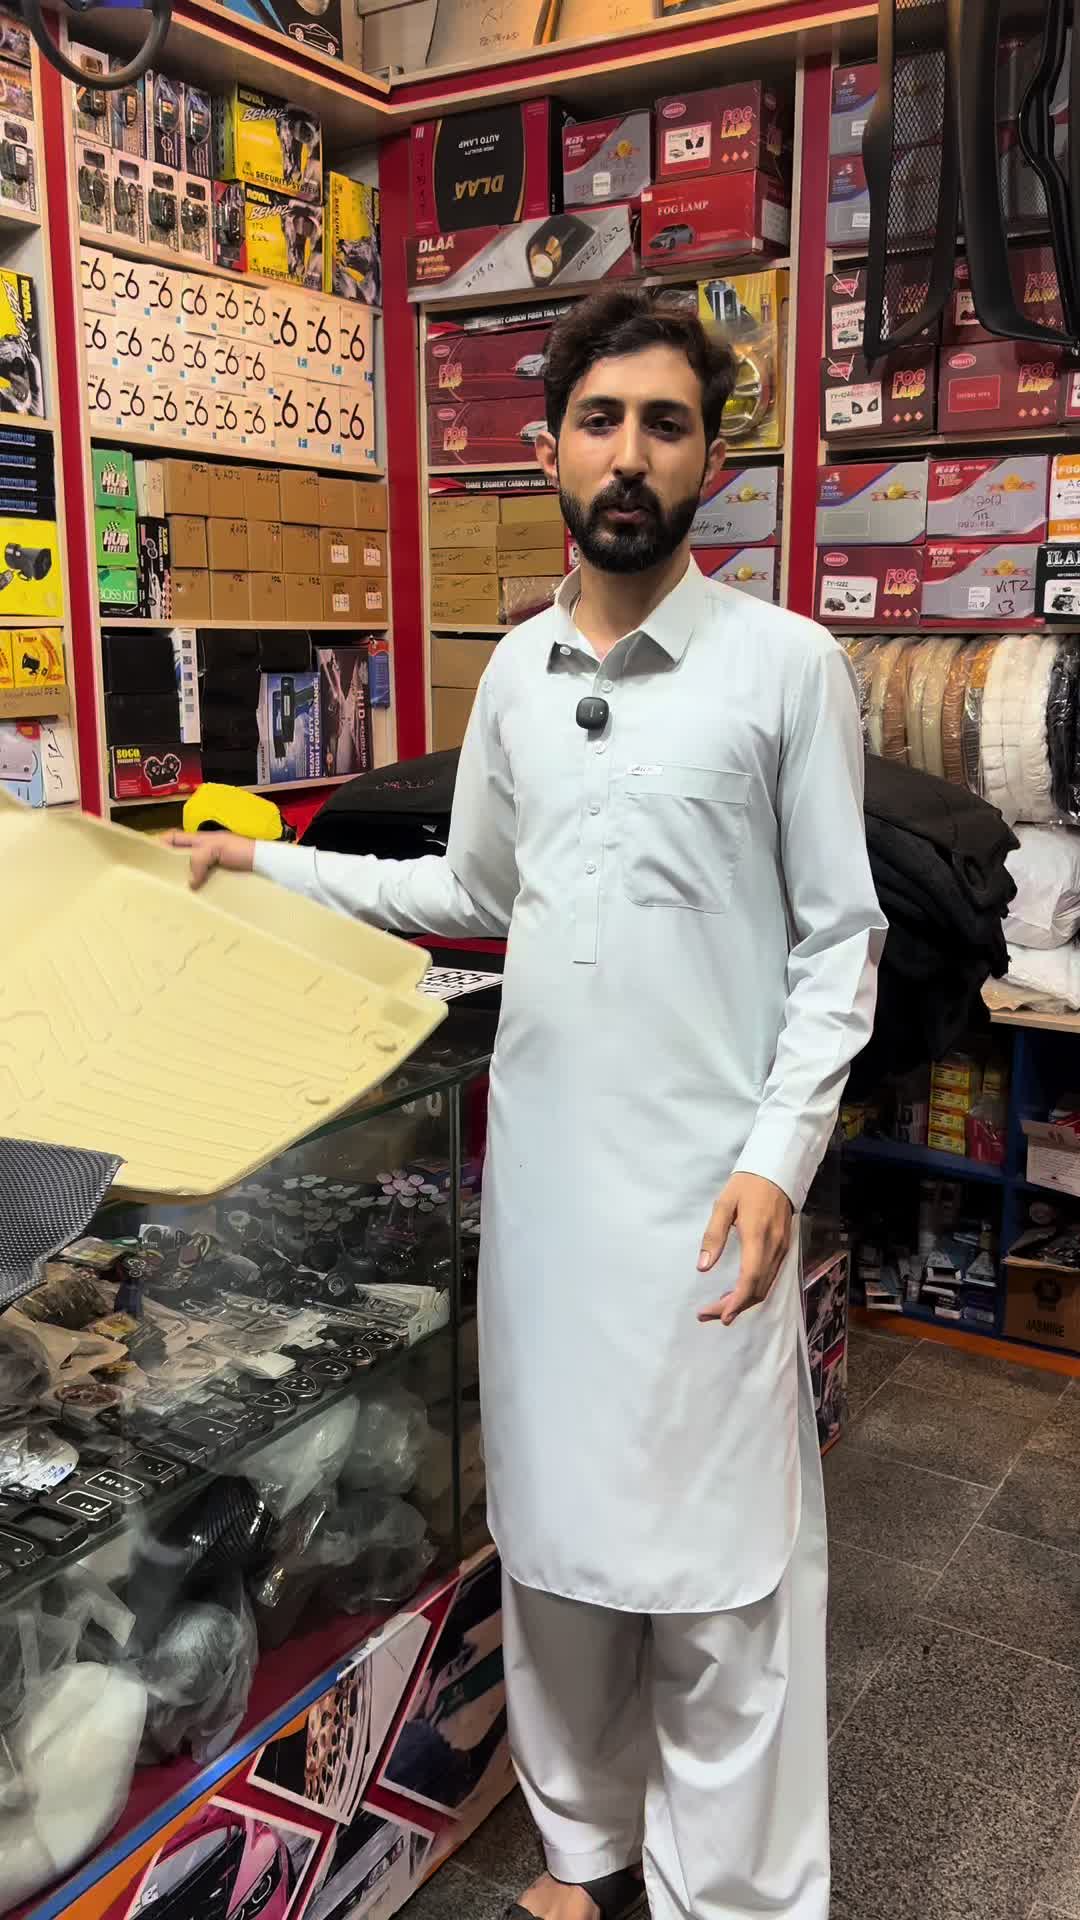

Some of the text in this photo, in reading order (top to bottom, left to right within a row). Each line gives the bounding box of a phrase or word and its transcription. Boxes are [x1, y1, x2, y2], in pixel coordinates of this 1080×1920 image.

[458, 133, 501, 149] AUTO LAMP
[455, 175, 504, 200] DLAA
[657, 200, 709, 216] FOG LAMP
[418, 234, 455, 253] DLAA
[181, 284, 208, 316] C6
[893, 368, 926, 387] FOG
[1019, 362, 1056, 381] FOG
[891, 383, 926, 400] LAMP
[482, 480, 508, 490] SEGMENT
[508, 479, 530, 488] CARBON
[530, 479, 546, 487] FIBER
[885, 568, 918, 584] FOG
[883, 582, 917, 598] LAMP
